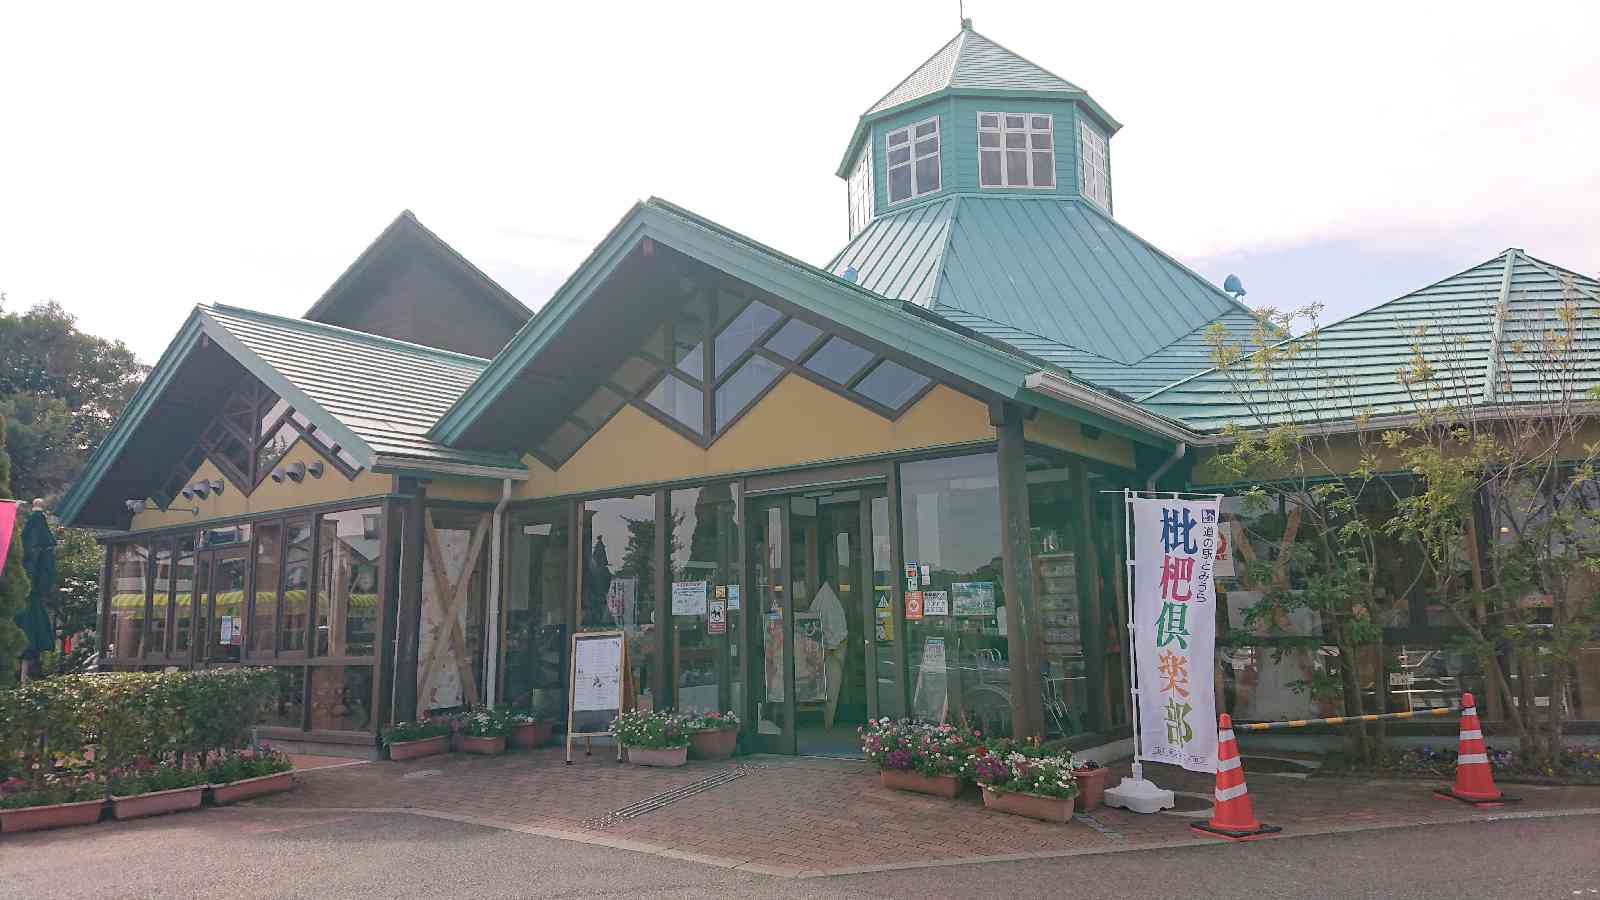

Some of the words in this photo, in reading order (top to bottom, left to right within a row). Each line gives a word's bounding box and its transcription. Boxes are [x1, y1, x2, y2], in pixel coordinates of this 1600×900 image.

[1197, 526, 1214, 603] 道の駅とみうら
